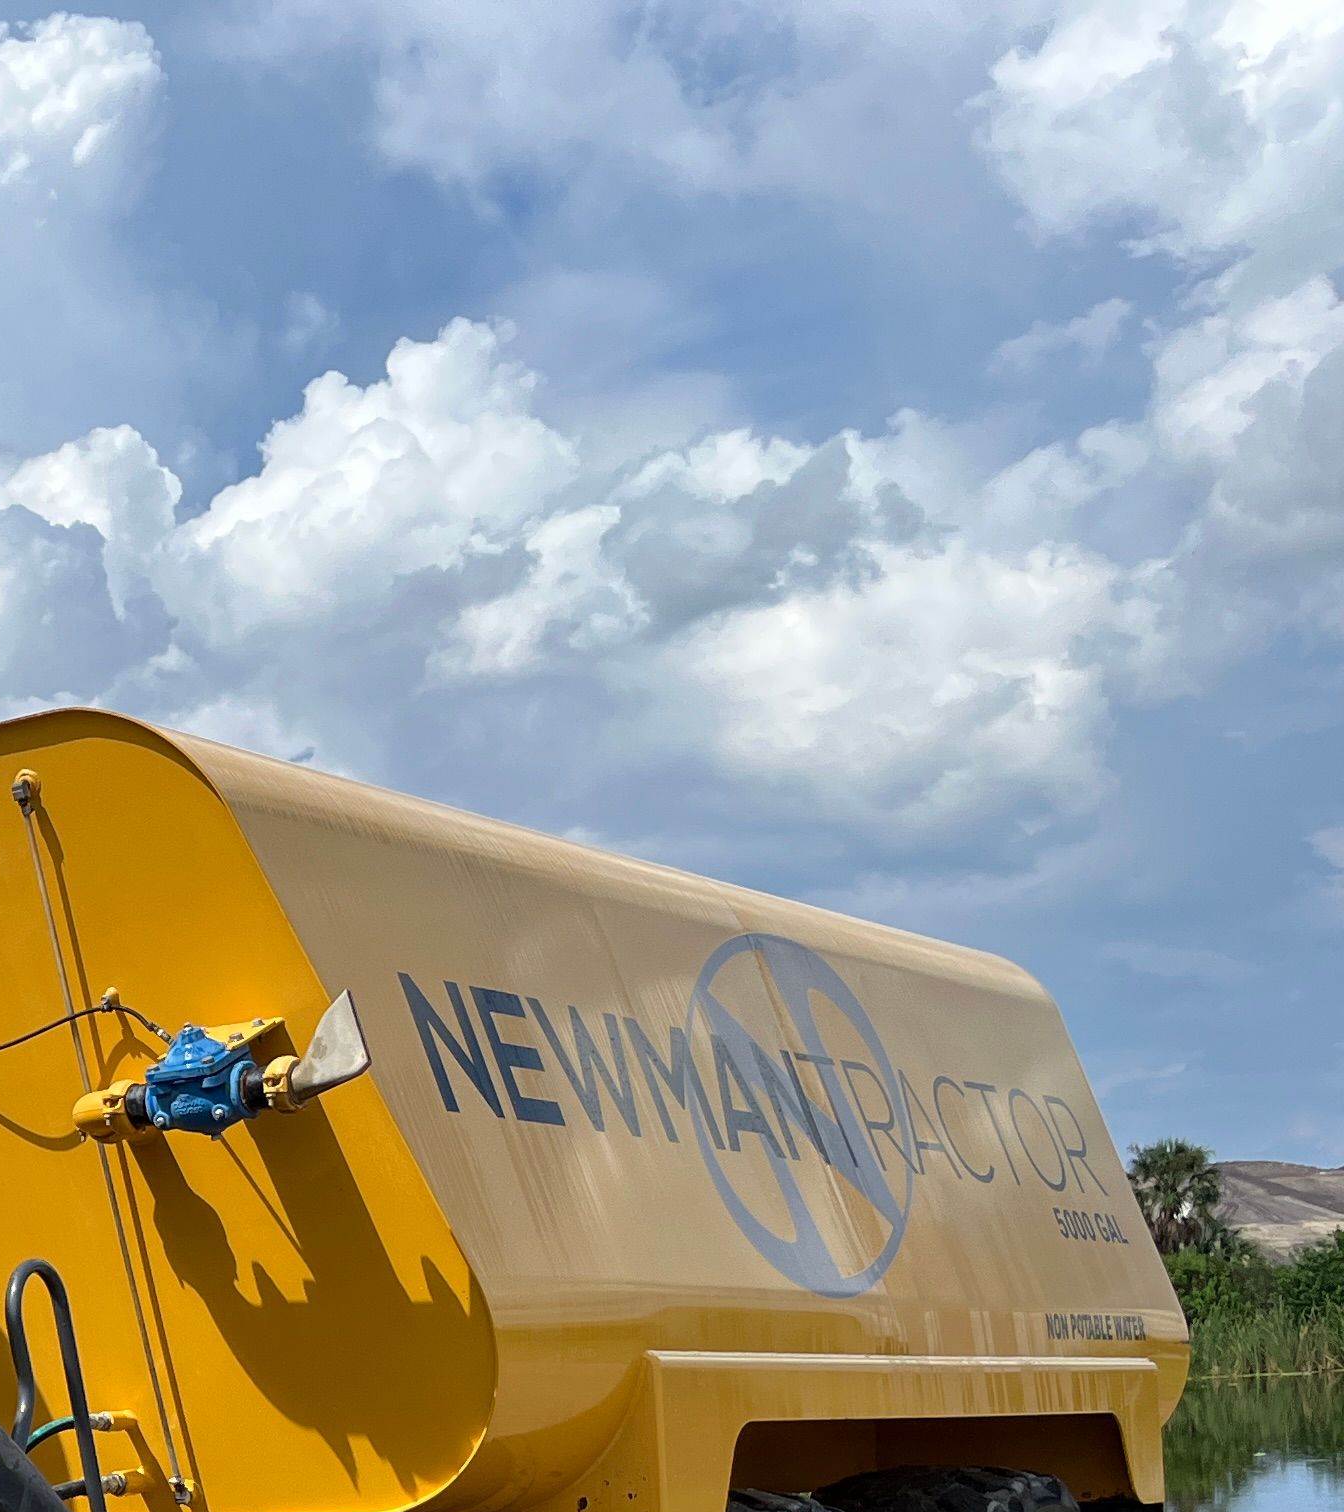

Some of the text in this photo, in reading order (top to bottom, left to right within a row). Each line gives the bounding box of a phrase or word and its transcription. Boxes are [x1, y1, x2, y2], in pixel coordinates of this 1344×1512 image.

[1052, 1207, 1129, 1244] 5000 GAL
[1045, 1313, 1147, 1342] NON POTABLE WATER
